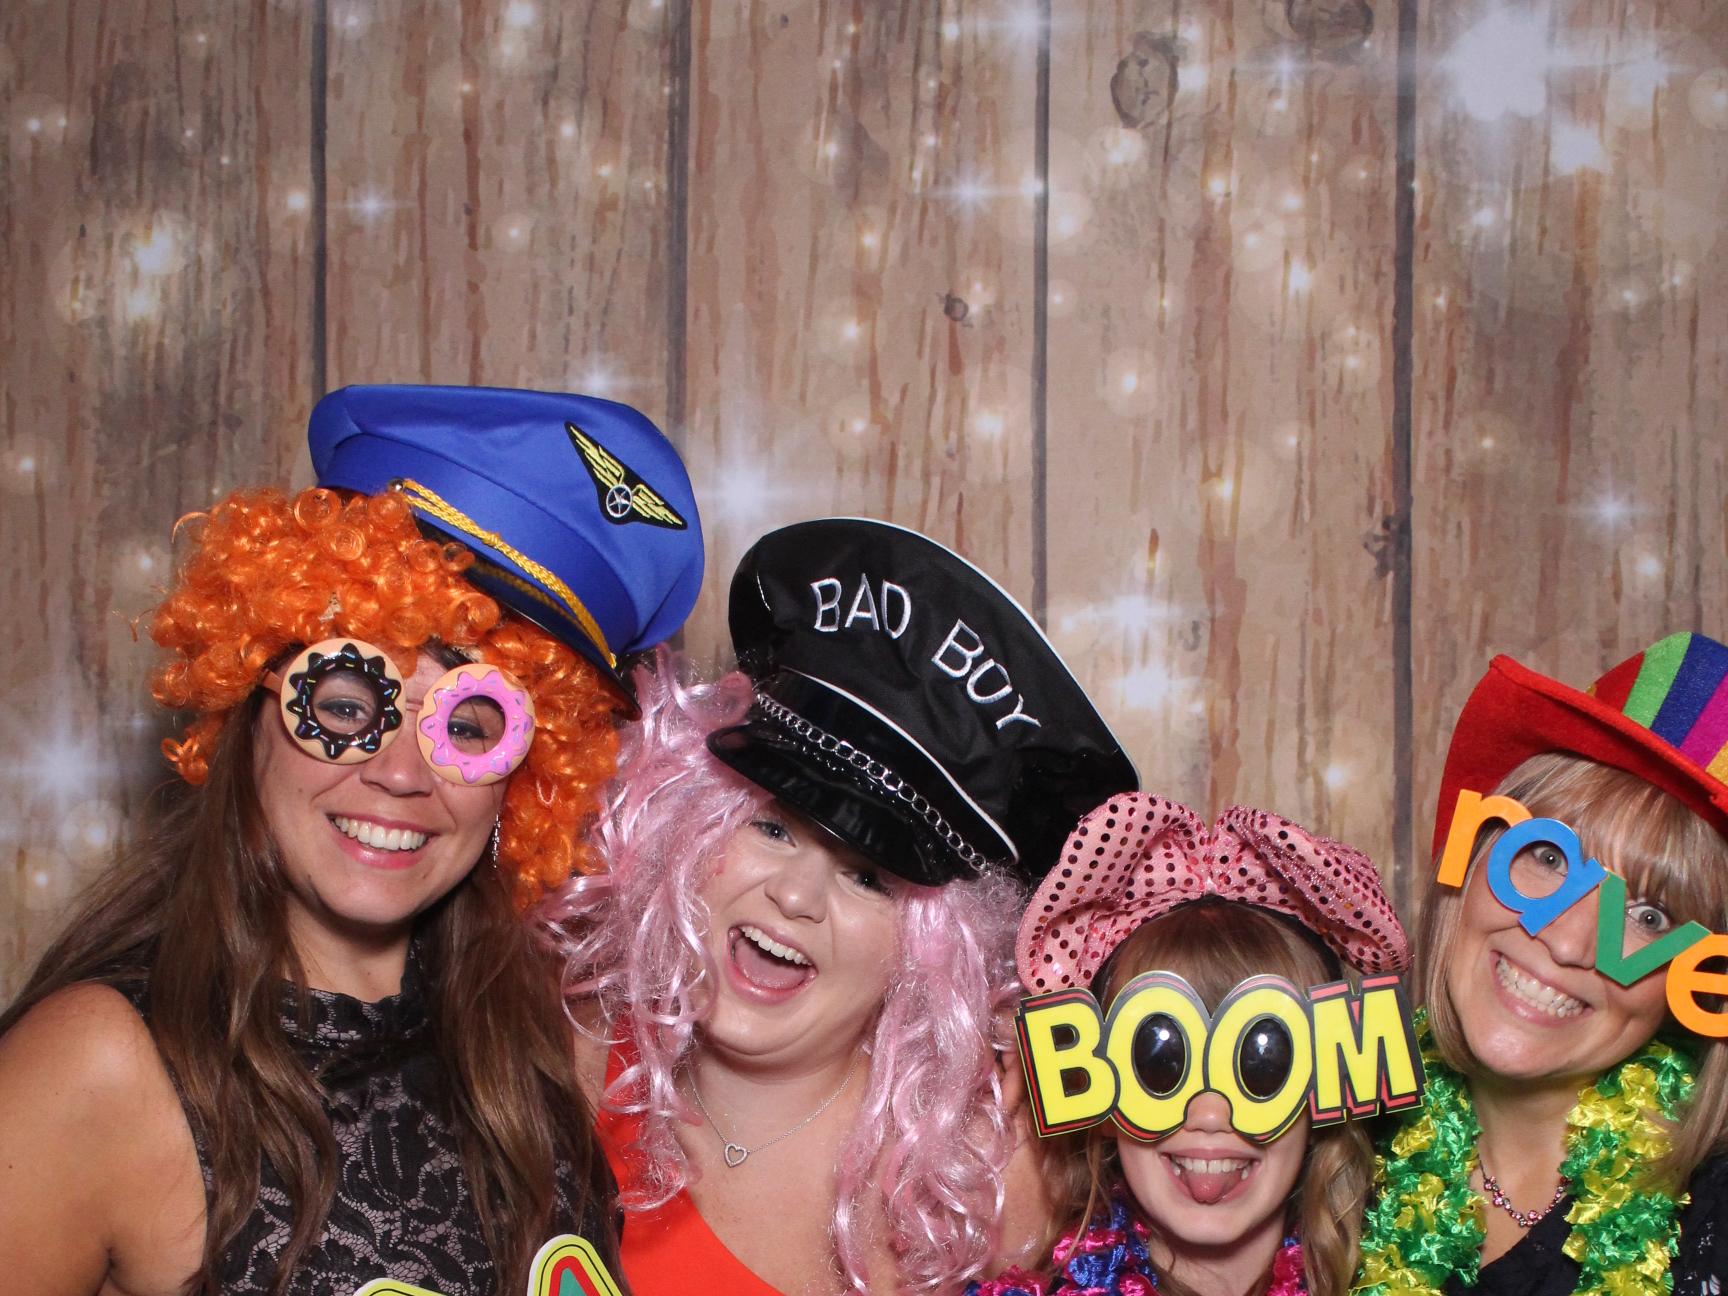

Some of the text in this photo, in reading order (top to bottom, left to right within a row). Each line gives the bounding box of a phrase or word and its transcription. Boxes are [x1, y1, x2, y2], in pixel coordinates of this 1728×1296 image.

[810, 573, 1041, 730] BAD BOY
[1024, 982, 1418, 1134] BOOM
